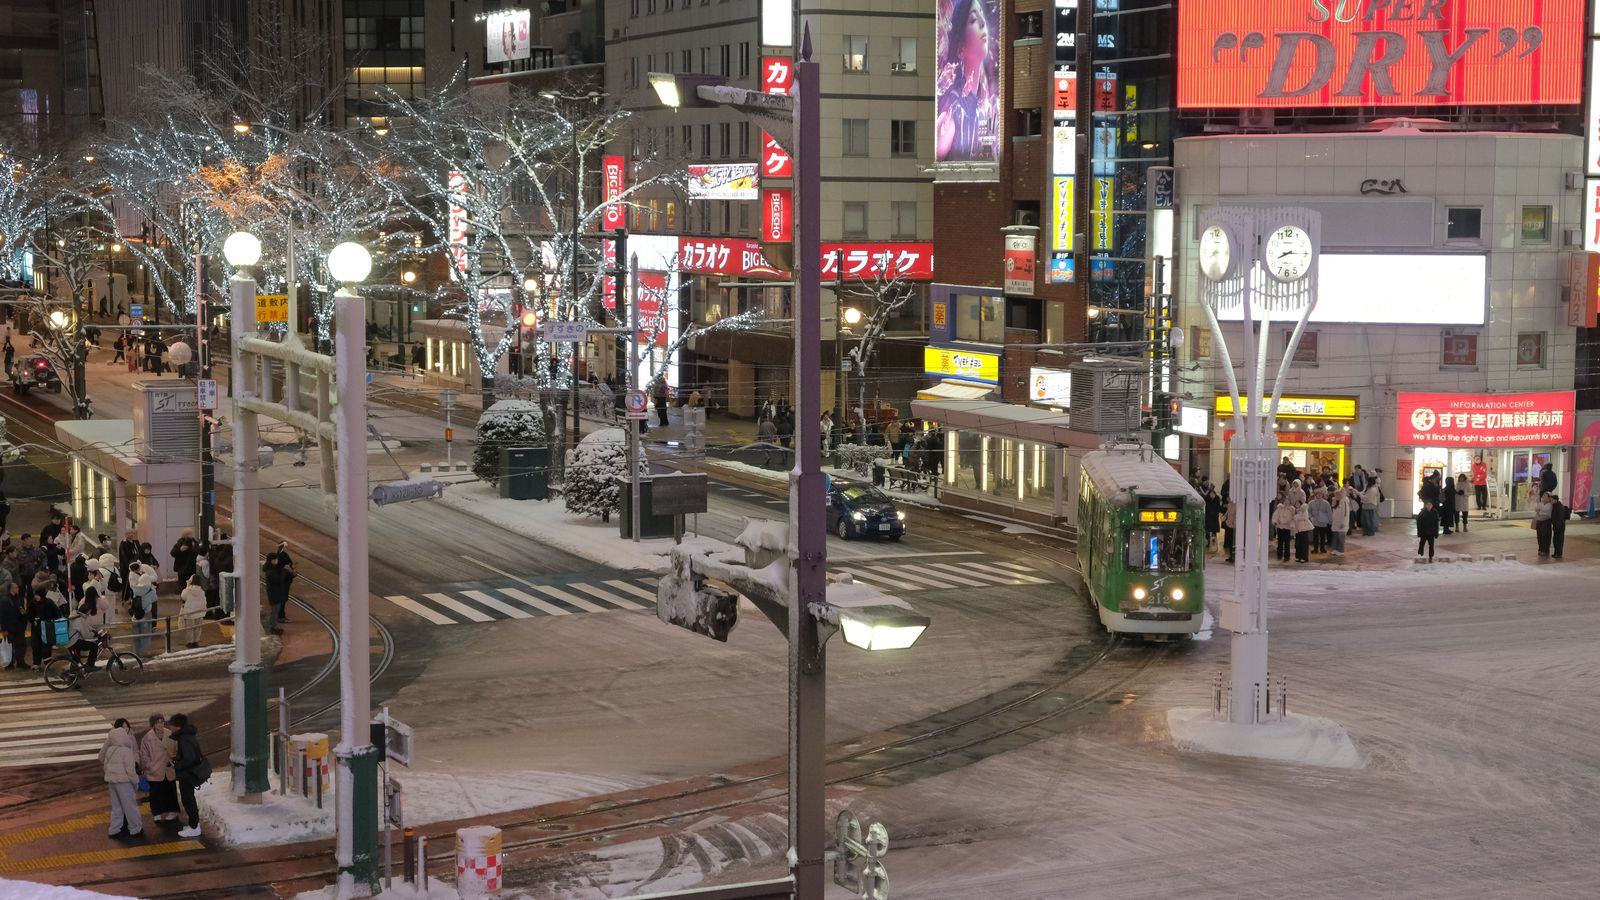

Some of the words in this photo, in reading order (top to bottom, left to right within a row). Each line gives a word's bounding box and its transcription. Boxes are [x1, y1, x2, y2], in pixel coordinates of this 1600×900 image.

[607, 164, 618, 188] BIG
[772, 193, 780, 211] BIG
[772, 212, 780, 239] ECHO
[1277, 232, 1284, 240] 11
[1284, 229, 1293, 237] 12
[683, 242, 731, 268] カラオケ
[742, 250, 759, 271] BIG
[821, 250, 919, 274] カラオケ
[1277, 266, 1283, 275] 7
[1284, 269, 1290, 277] 6
[1292, 266, 1298, 275] 5
[1450, 401, 1507, 409] INFORMATION
[1509, 400, 1535, 409] CENTER
[1438, 410, 1564, 429] すすきの無料案内所
[1432, 433, 1446, 441] find
[1461, 434, 1479, 443] right
